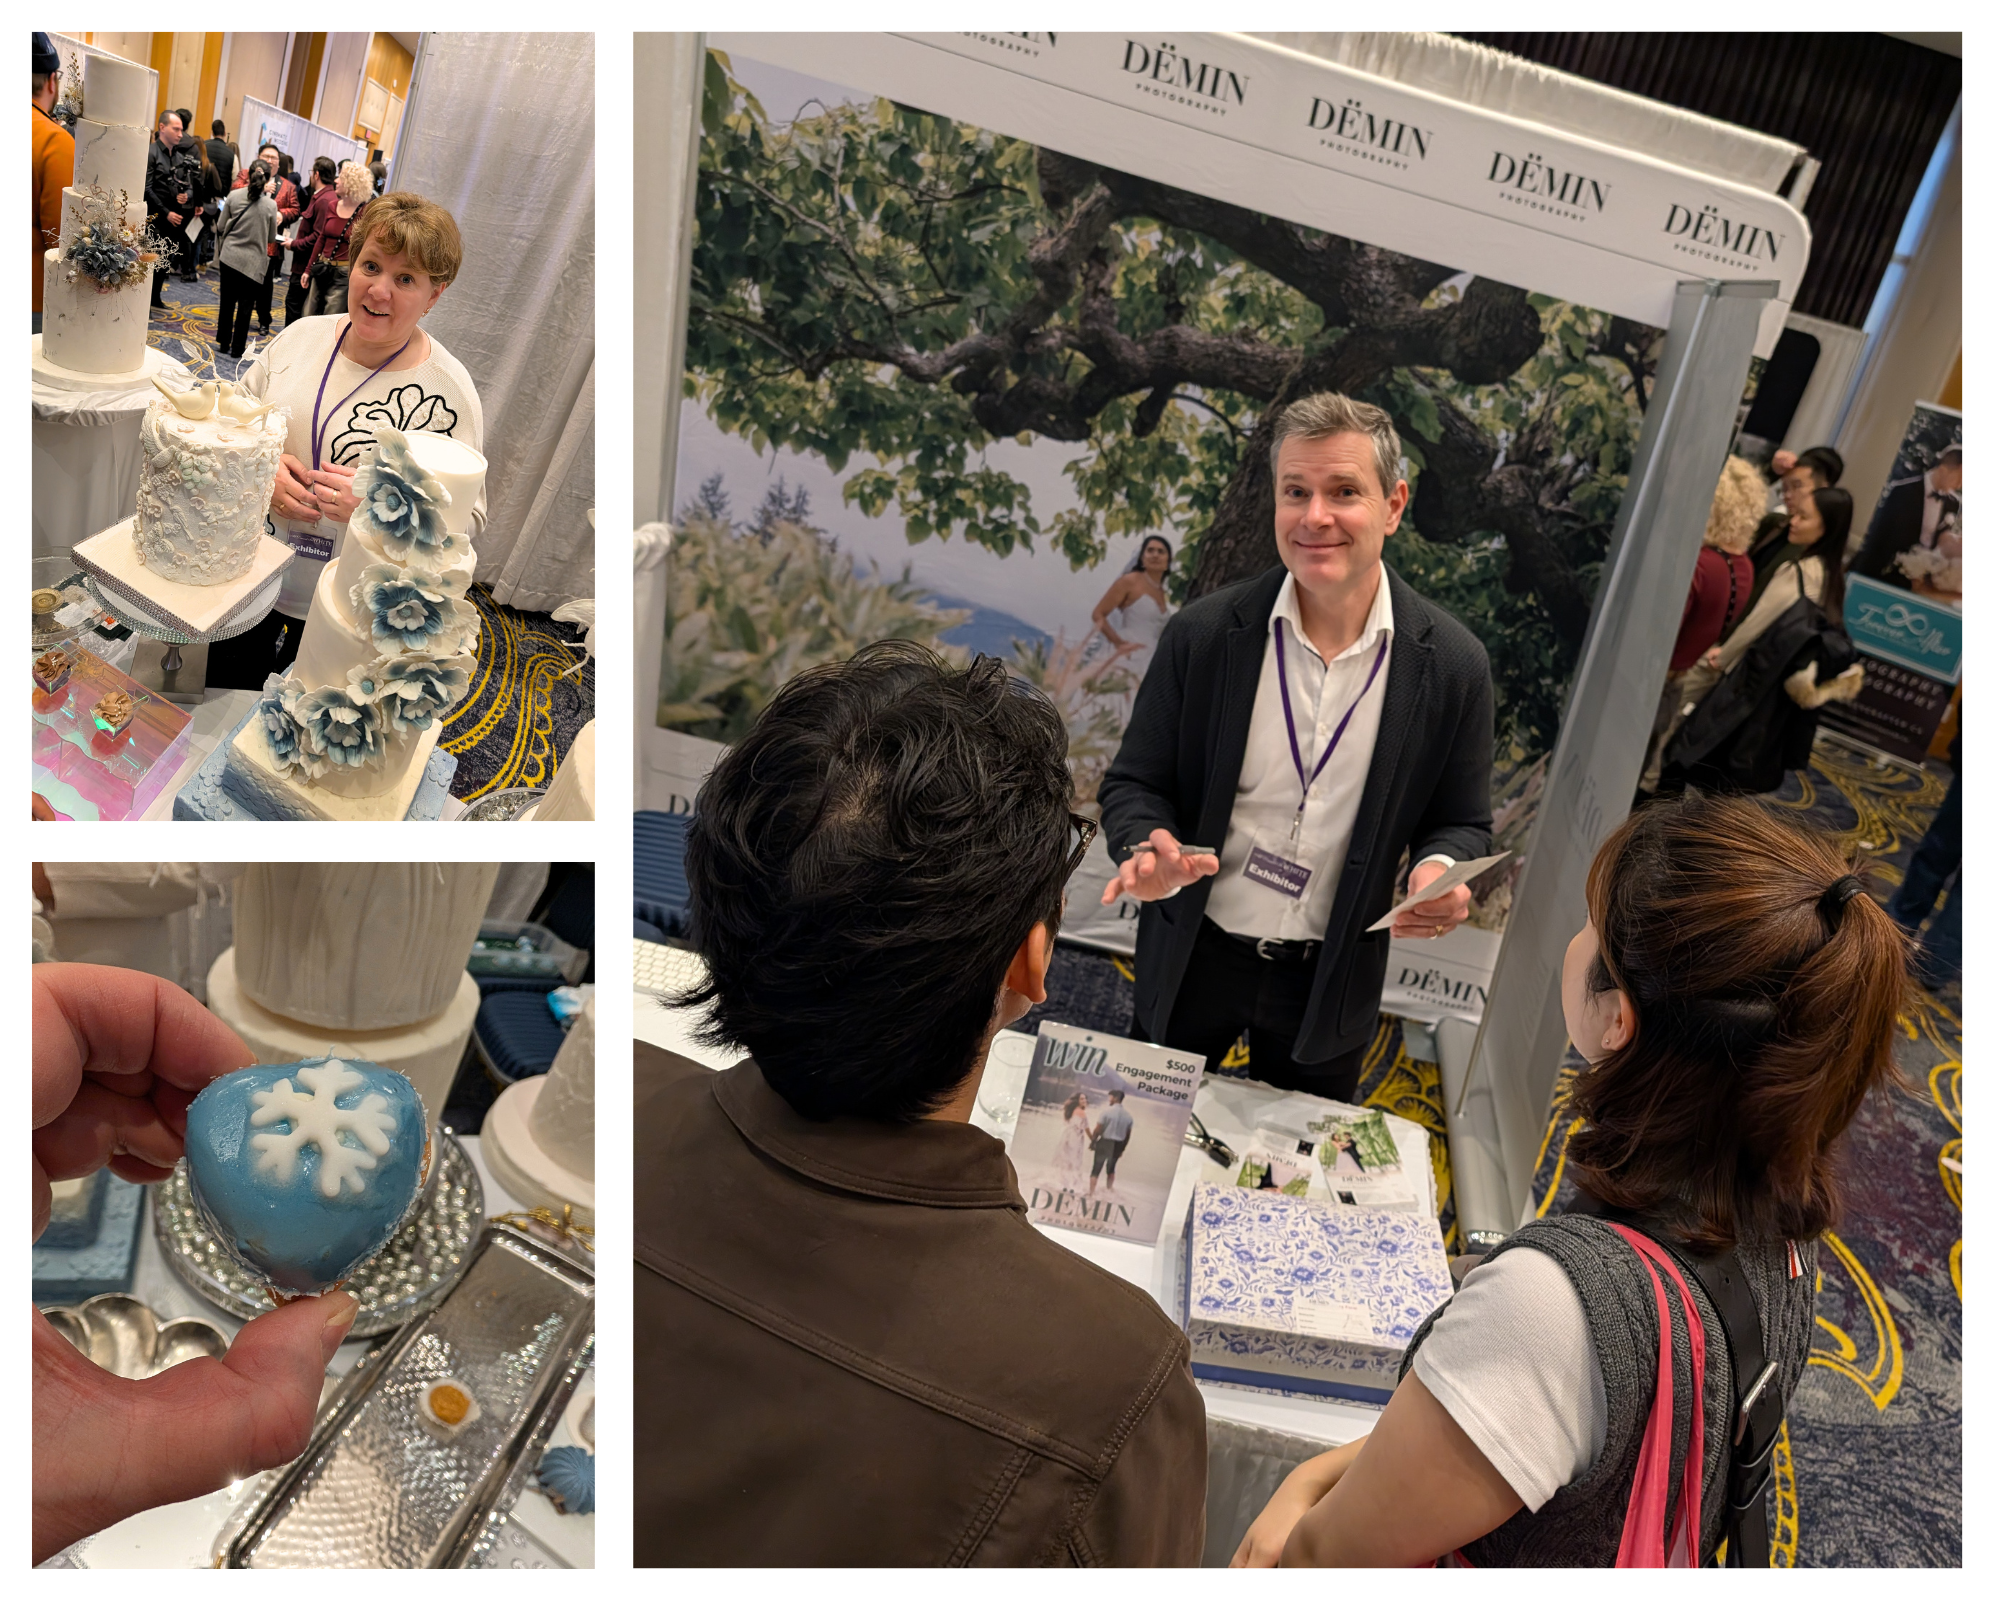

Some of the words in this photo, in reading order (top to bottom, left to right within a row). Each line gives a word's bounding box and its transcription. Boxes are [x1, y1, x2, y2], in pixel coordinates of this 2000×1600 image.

[1119, 40, 1250, 106] DËMIN
[1136, 83, 1226, 116] PHOTOGRAPHY
[1306, 97, 1434, 160] DËMIN
[1320, 139, 1408, 171] PHOTOGRAPHY
[1487, 151, 1612, 213] DËMIN
[1499, 192, 1586, 222] PHOTOGRAPHY
[1661, 204, 1786, 263] DËMIN
[1674, 243, 1758, 271] PHOTOGRAPHY
[1248, 863, 1301, 893] Exhibitor
[1115, 1062, 1192, 1087] Engagement
[1166, 1059, 1195, 1074] $500
[1137, 1081, 1189, 1101] Package
[1030, 1187, 1136, 1227] DËMIN
